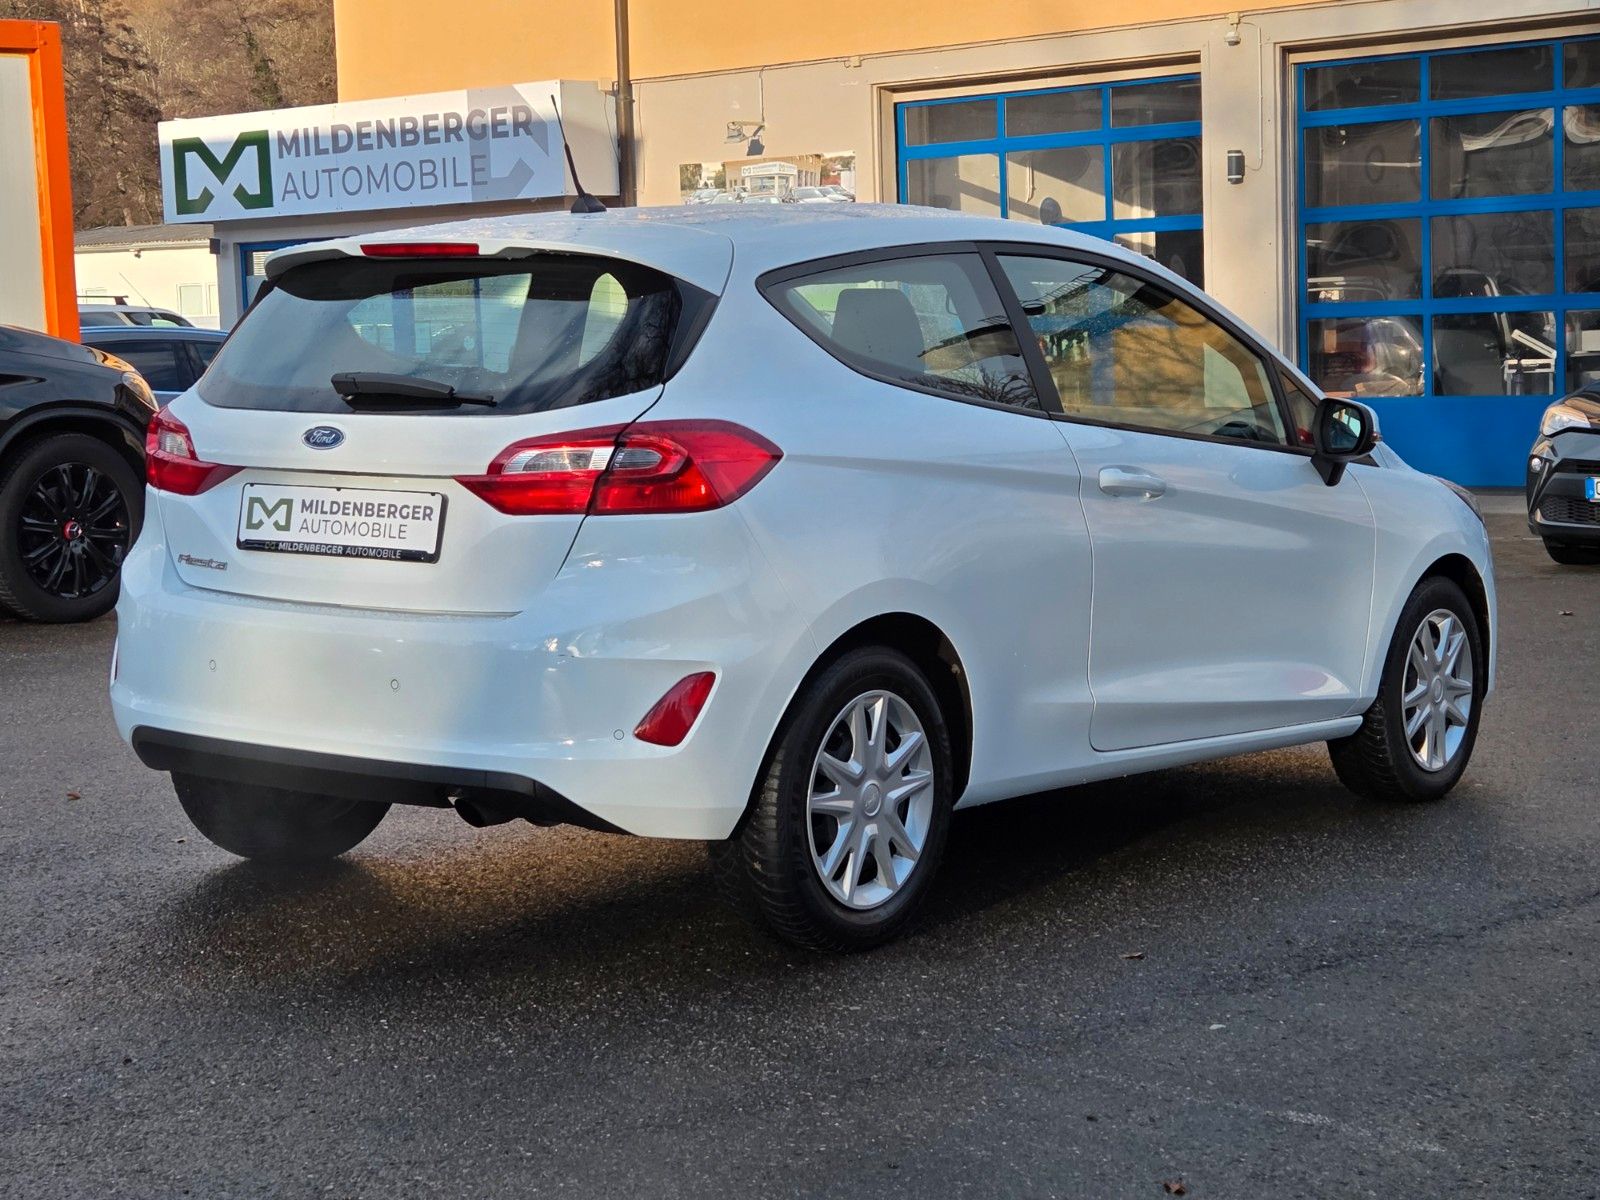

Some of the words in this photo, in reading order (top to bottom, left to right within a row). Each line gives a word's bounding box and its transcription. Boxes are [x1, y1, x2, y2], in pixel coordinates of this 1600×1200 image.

[276, 105, 533, 159] MILDENBERGER
[281, 154, 488, 202] AUTOMOBILE
[300, 499, 434, 521] MILDENBERGER
[299, 518, 408, 540] AUTOMOBILE
[278, 541, 343, 555] MILDENBERGER
[345, 544, 401, 559] AUTOMOBILE
